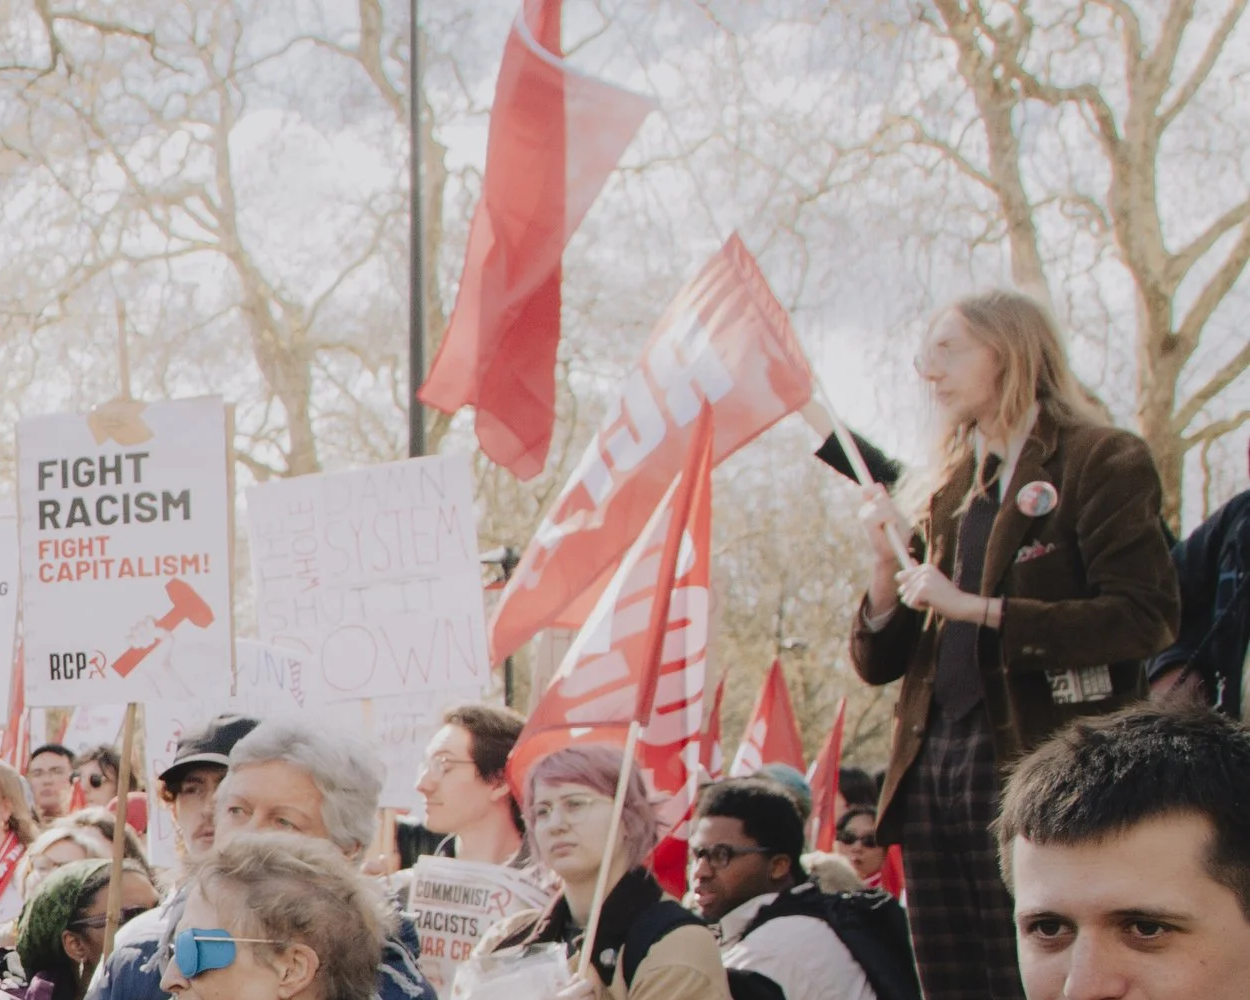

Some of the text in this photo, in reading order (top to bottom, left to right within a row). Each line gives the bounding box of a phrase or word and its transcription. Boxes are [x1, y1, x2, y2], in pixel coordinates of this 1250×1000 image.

[37, 452, 150, 491] FIGHT
[38, 489, 192, 531] RACISM
[37, 535, 111, 560] FIGHT
[323, 503, 471, 577] SYSTEM
[38, 553, 211, 584] CAPITALISM!
[50, 652, 87, 681] RCP
[271, 614, 479, 692] OWN
[415, 879, 491, 908] COMMUNIST
